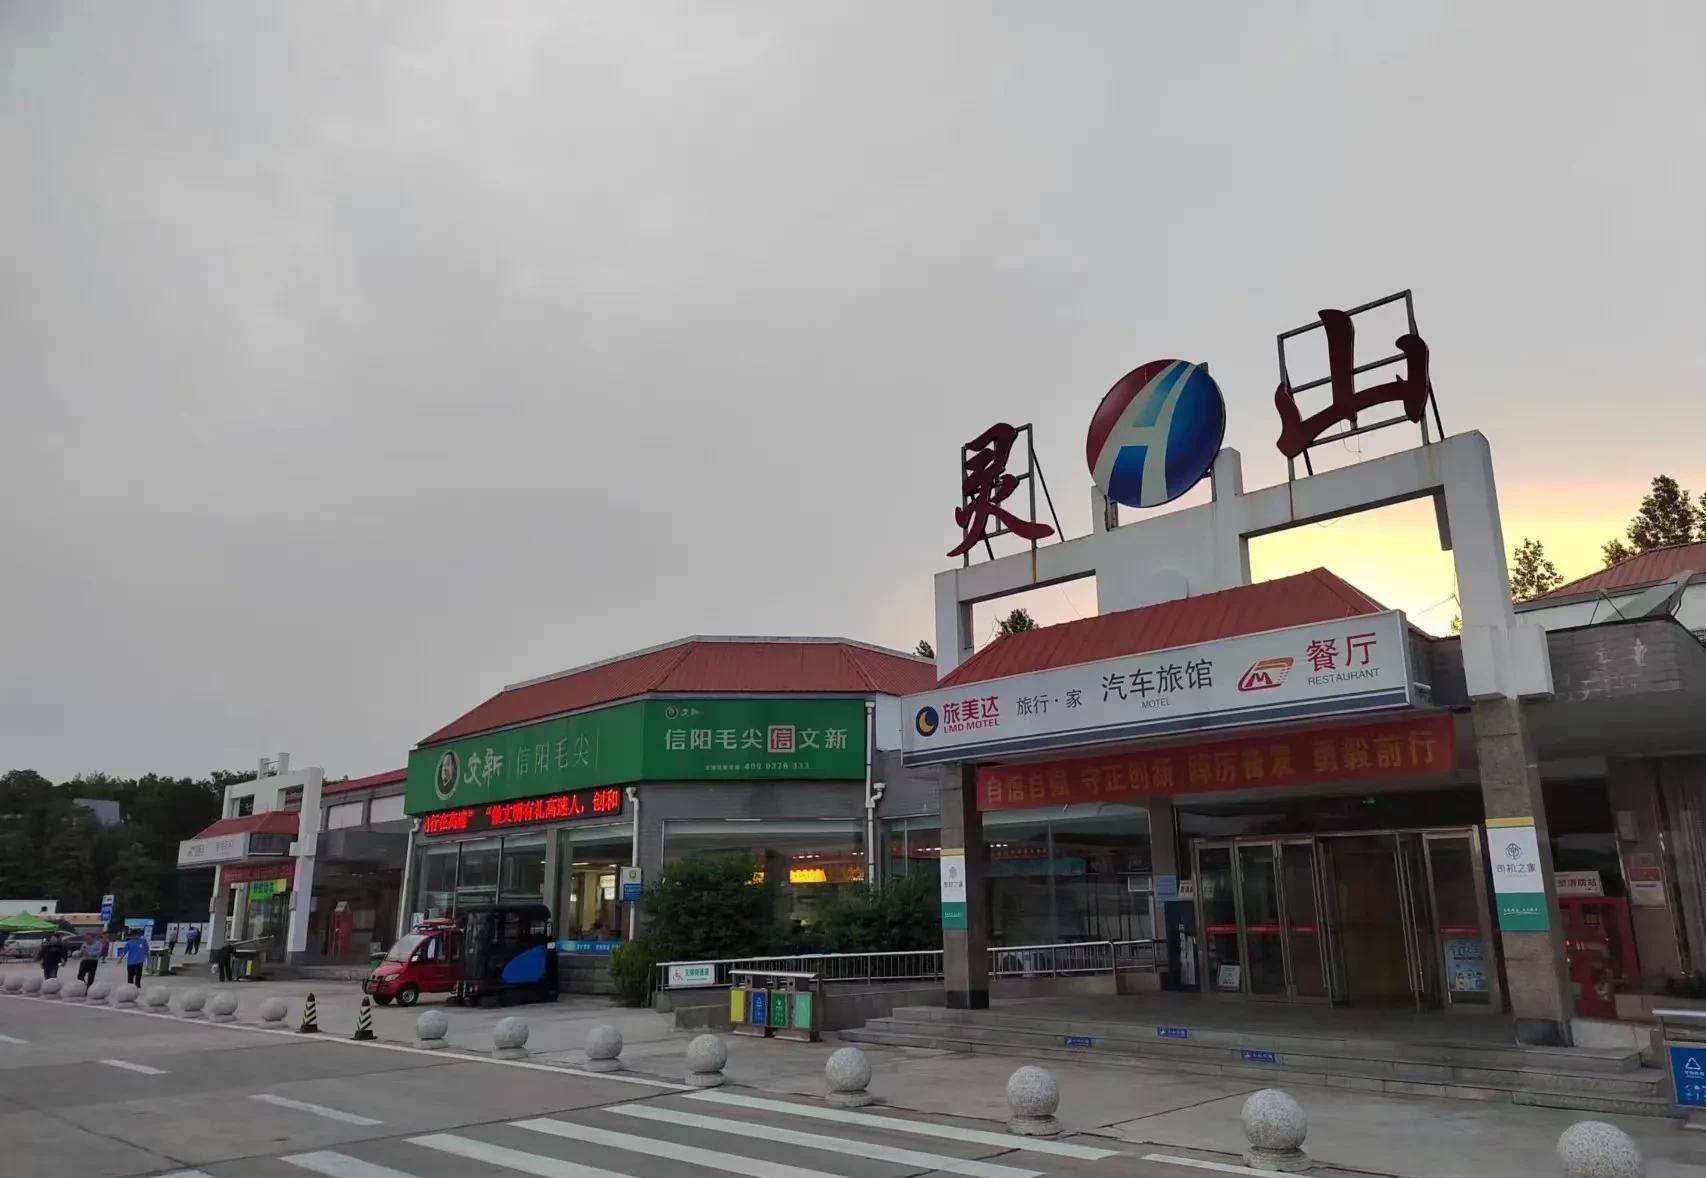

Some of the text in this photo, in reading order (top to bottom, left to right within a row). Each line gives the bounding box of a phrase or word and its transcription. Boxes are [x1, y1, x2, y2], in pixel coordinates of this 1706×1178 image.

[946, 308, 1430, 557] 灵 山
[1306, 632, 1377, 672] 餐厅
[1101, 658, 1213, 702] 汽车旅馆
[1307, 667, 1380, 686] RESTAURANT
[943, 696, 1000, 724] 旅美达
[1141, 698, 1171, 708] MOTEL
[943, 718, 1000, 734] LMD MOTEL
[516, 732, 590, 777] 信阳毛尖
[1496, 862, 1537, 875] 司机之家
